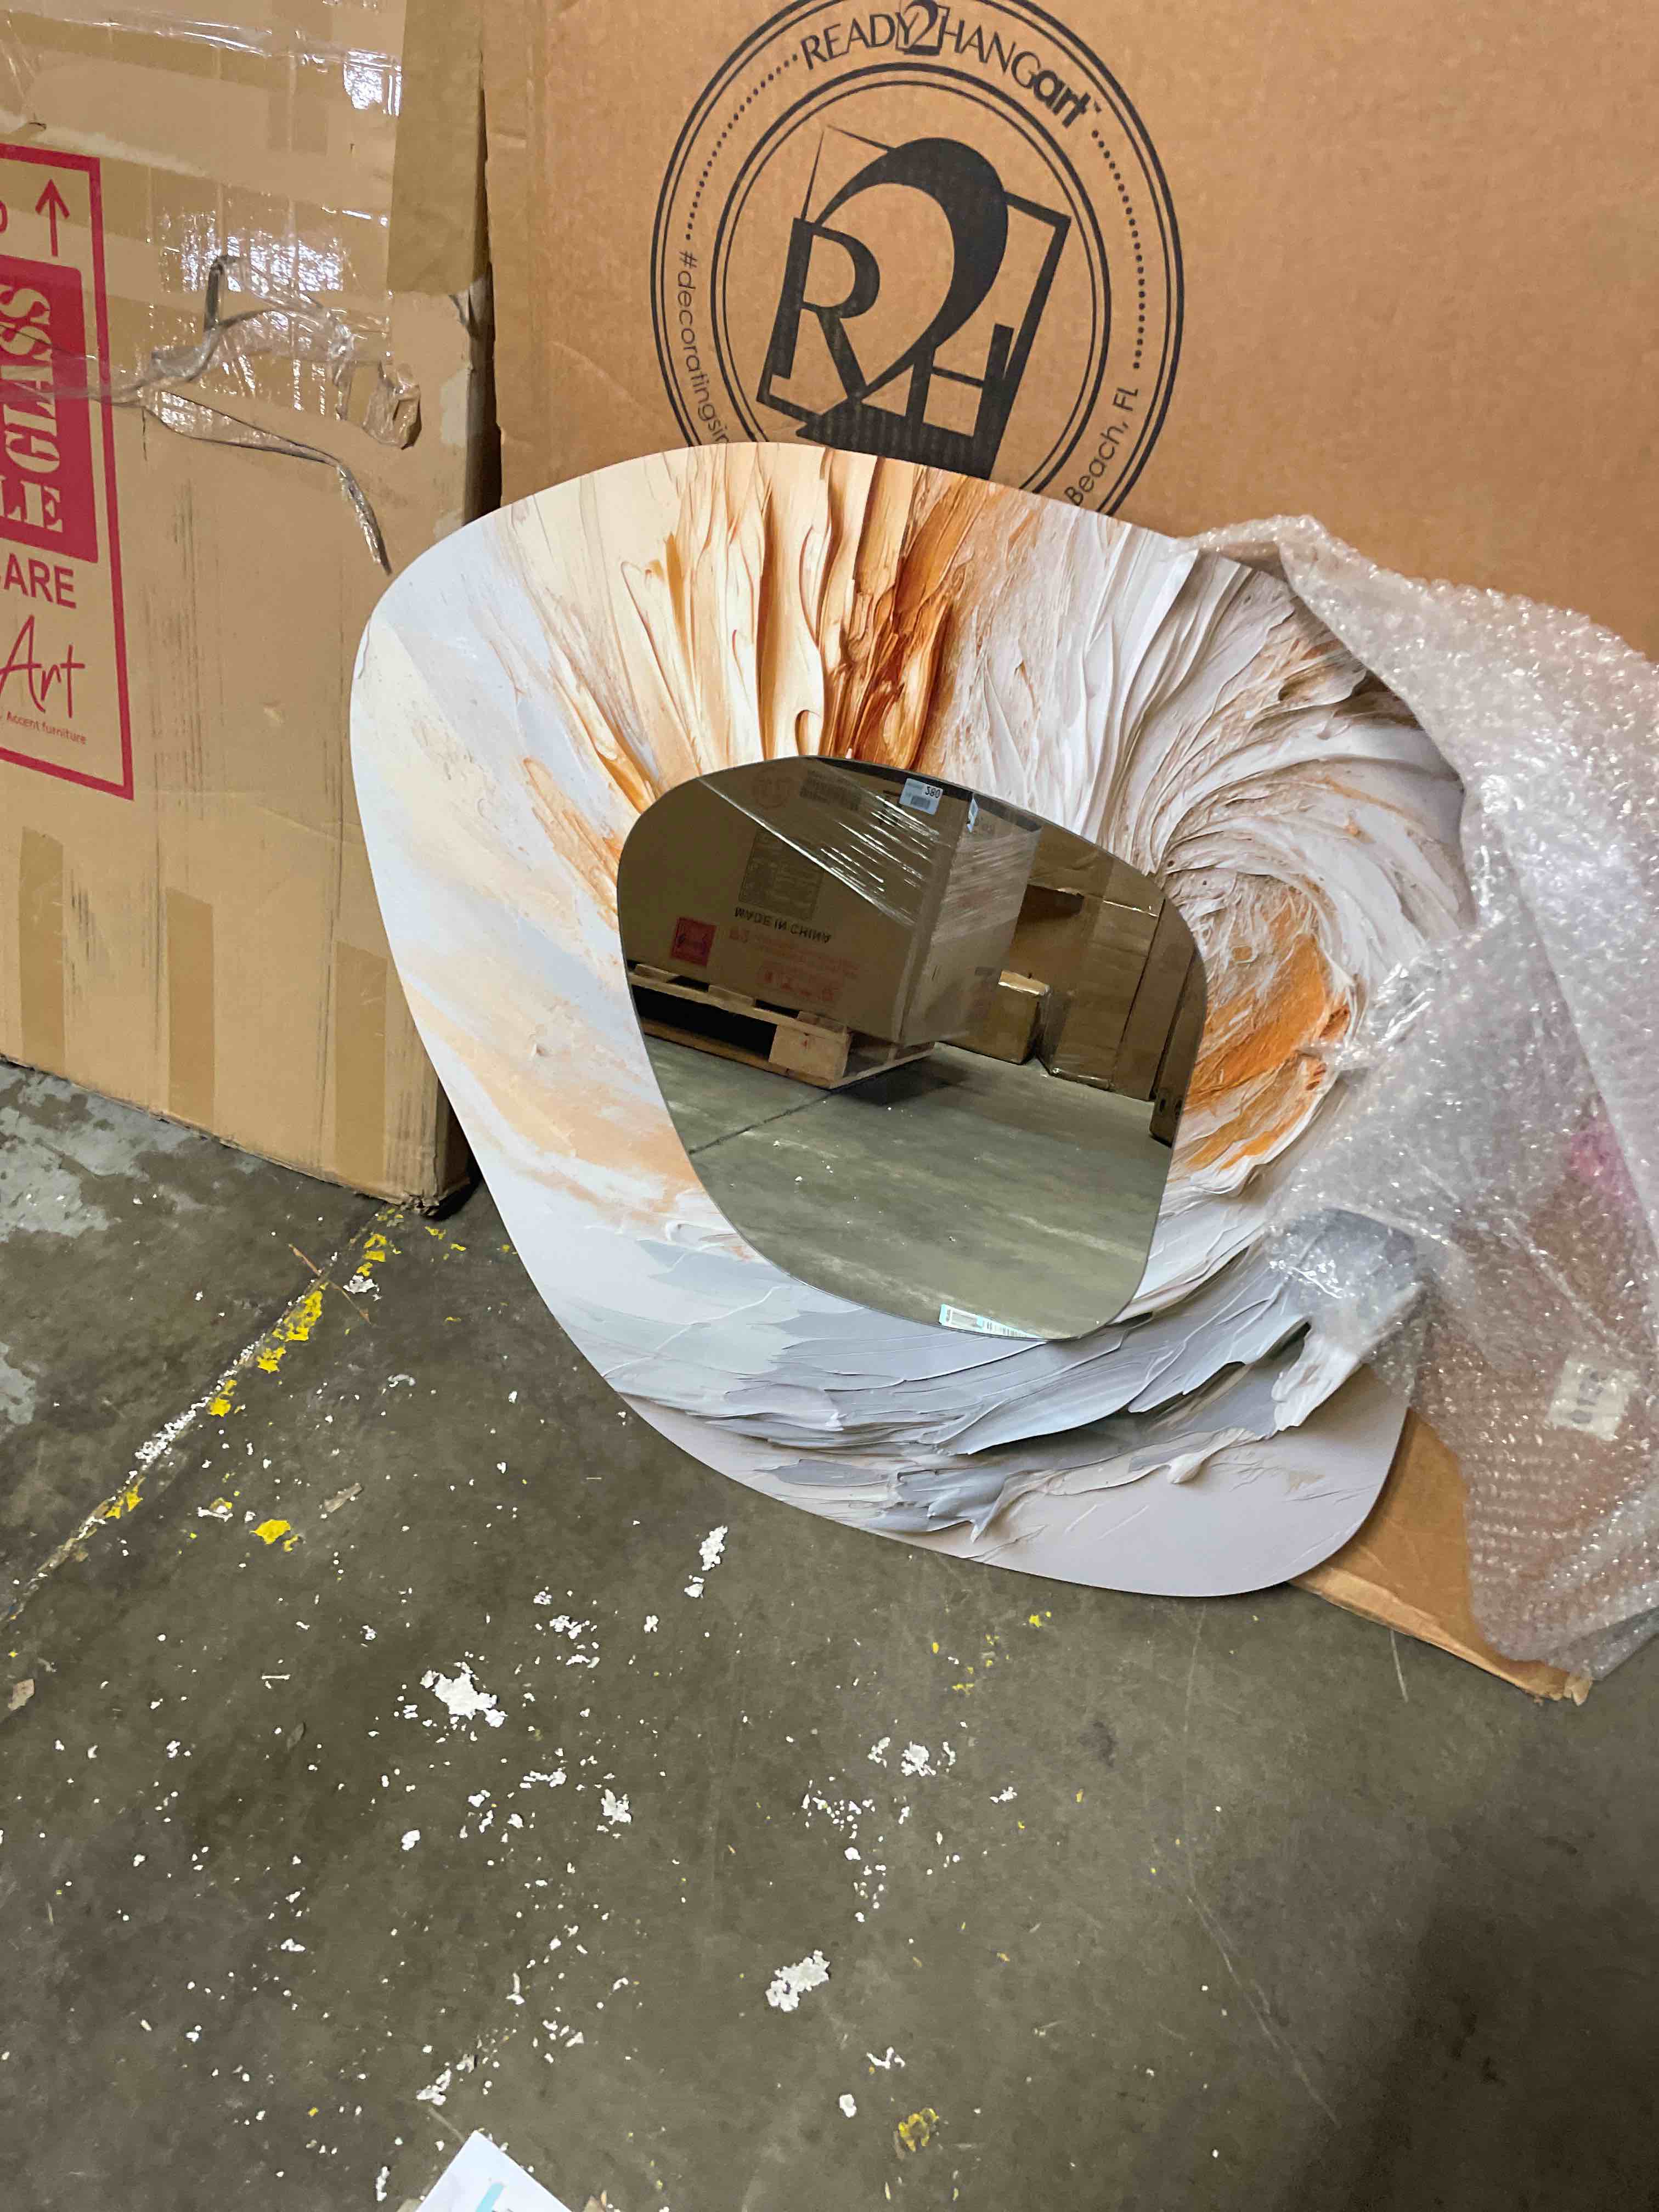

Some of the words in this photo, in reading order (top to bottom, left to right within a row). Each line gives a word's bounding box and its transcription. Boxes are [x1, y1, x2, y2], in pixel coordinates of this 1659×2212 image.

[0, 283, 60, 474] GLASS
[1064, 421, 1128, 506] Beach,
[1111, 387, 1138, 411] FL
[0, 614, 85, 718] Art
[7, 711, 40, 731] Accent
[42, 721, 86, 745] furniture
